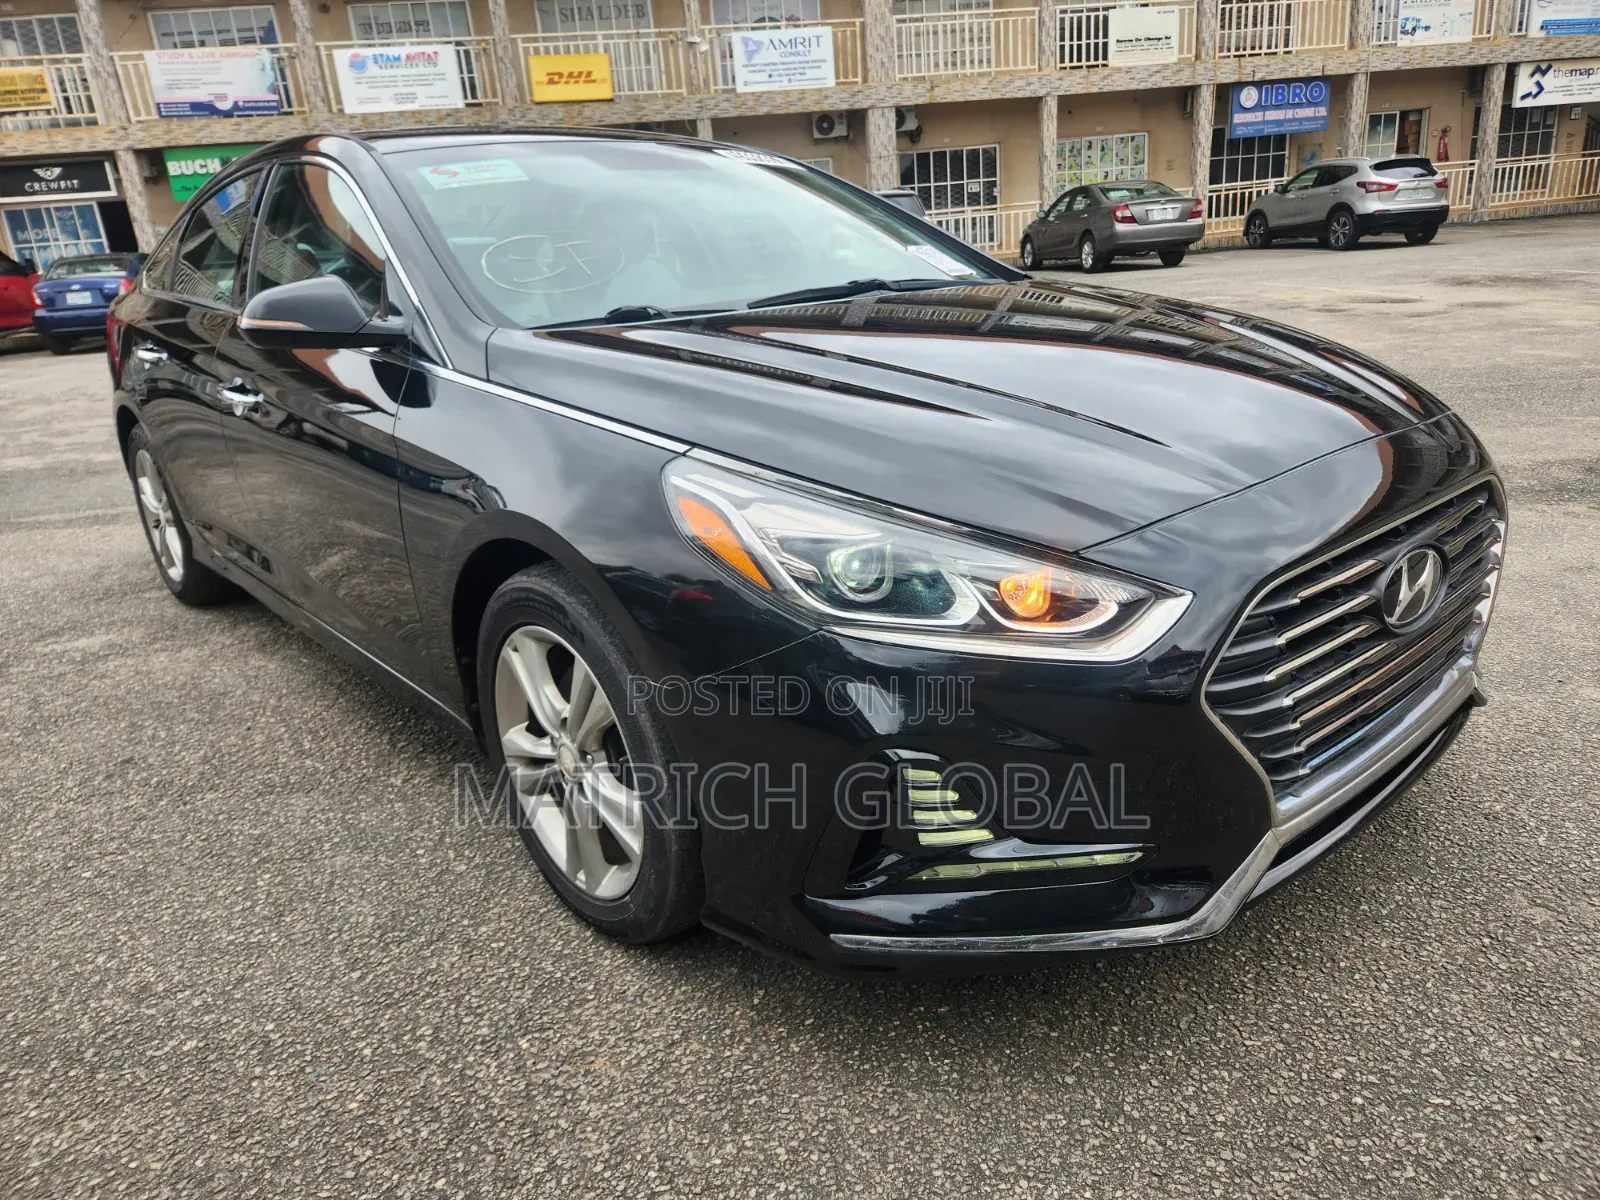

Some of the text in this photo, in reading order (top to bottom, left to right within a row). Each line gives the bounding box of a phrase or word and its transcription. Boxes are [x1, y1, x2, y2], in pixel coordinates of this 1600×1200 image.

[767, 34, 824, 51] AMRIT
[780, 50, 812, 58] CONSULT
[545, 70, 598, 86] DHL
[1261, 81, 1325, 106] IBRO
[25, 179, 79, 192] CREWFIT
